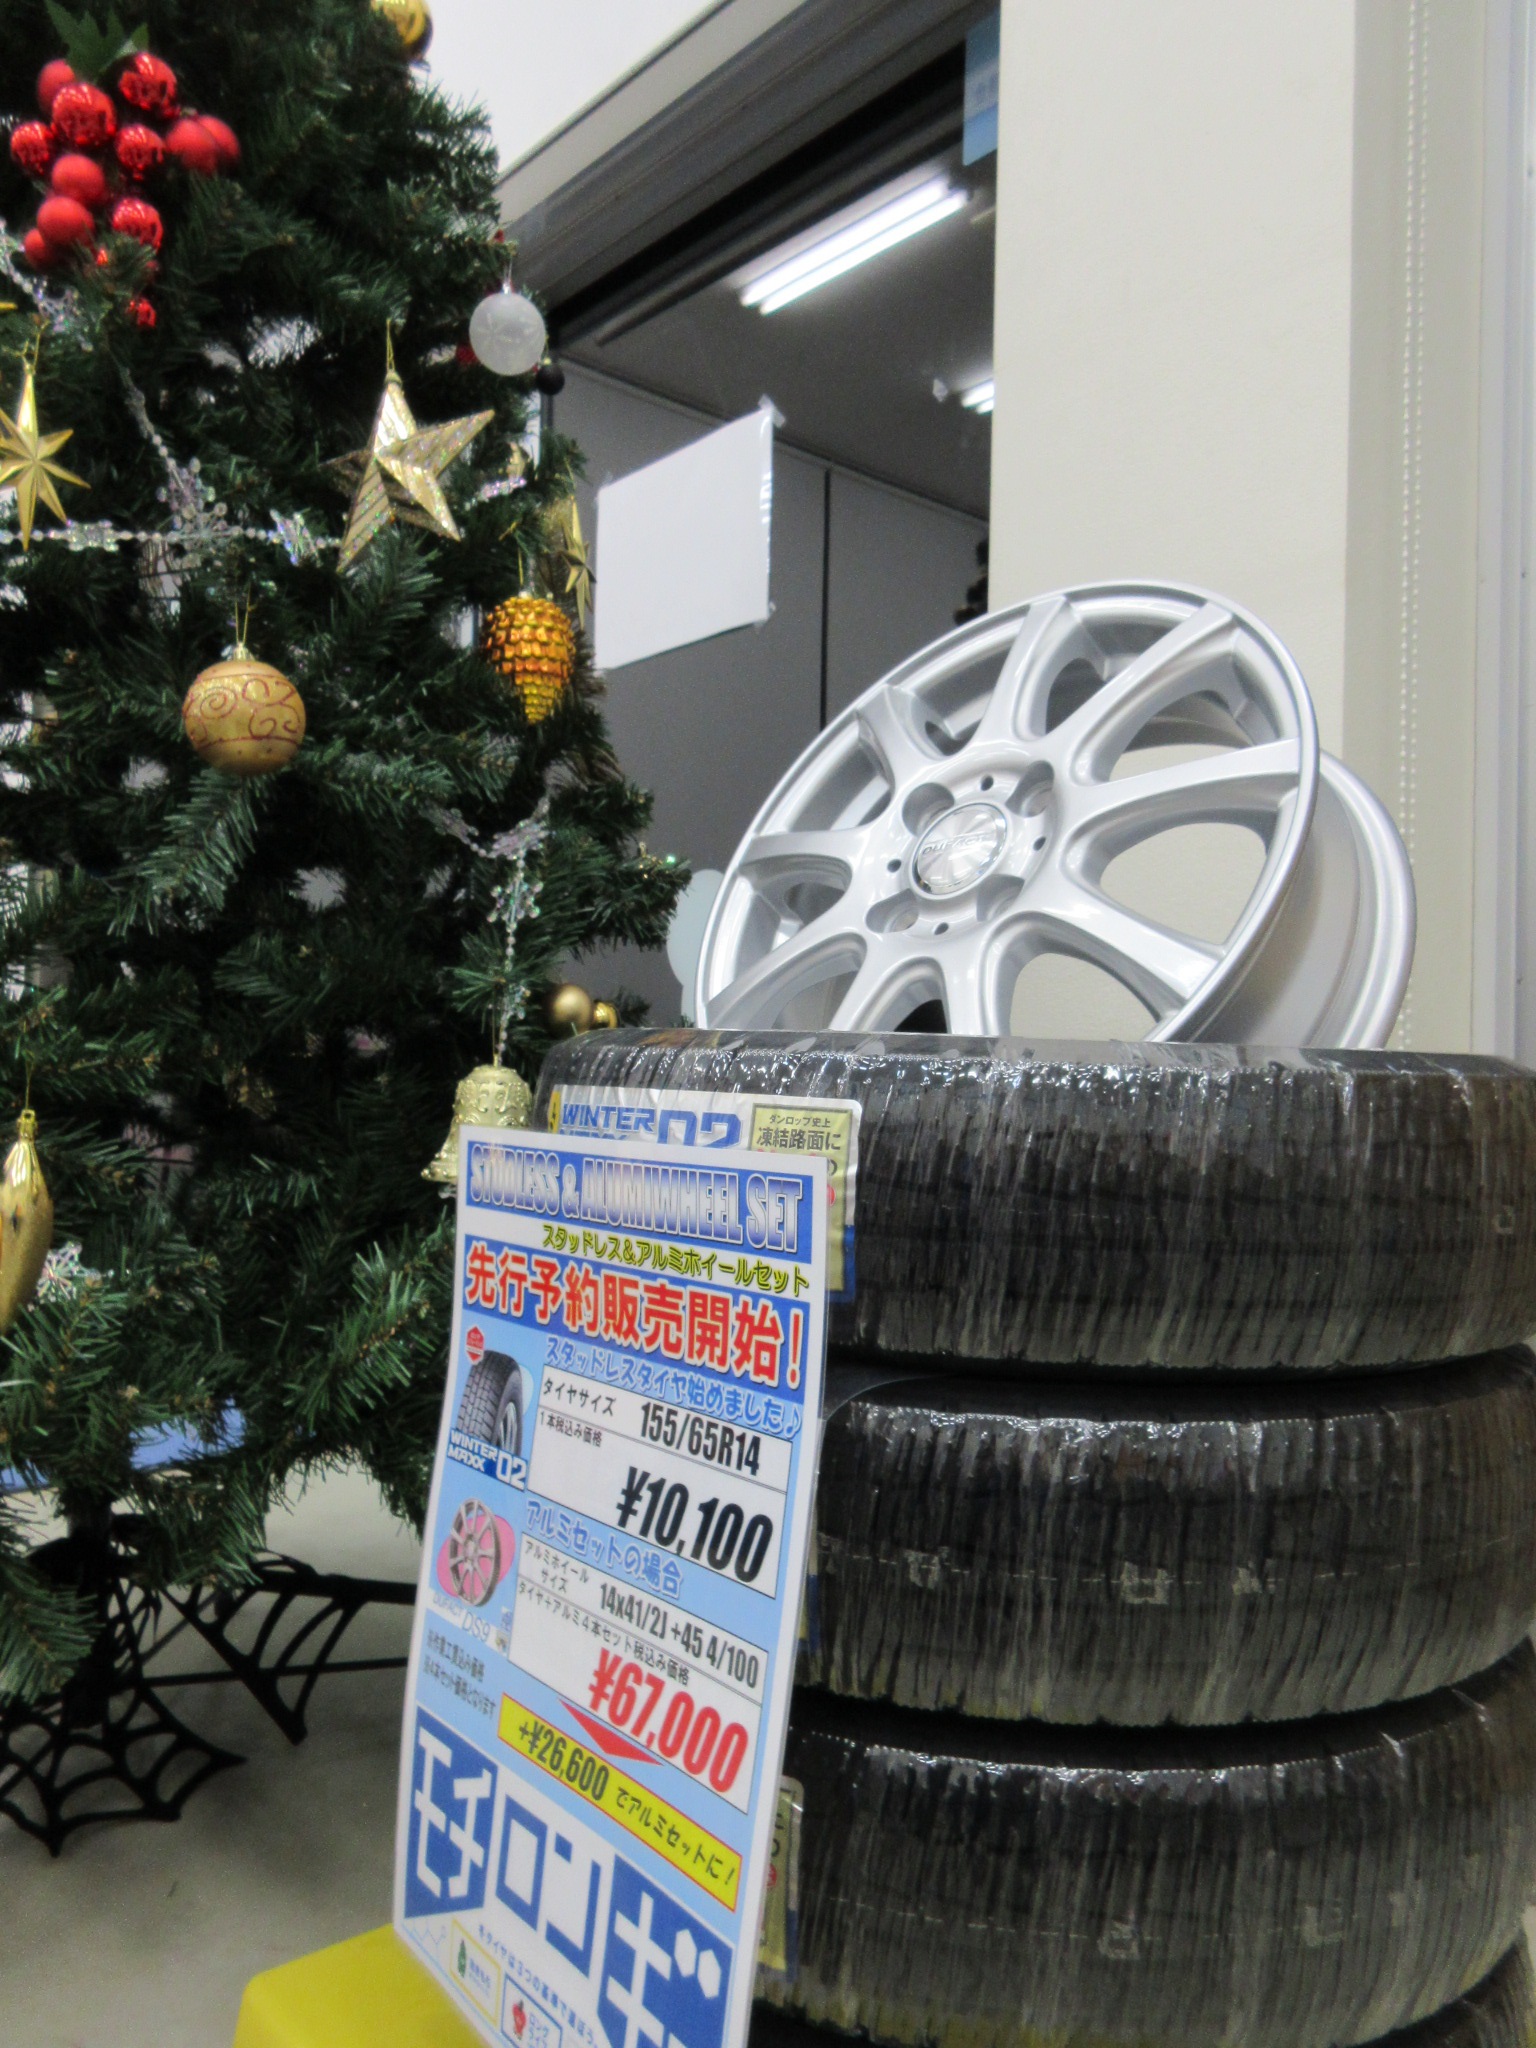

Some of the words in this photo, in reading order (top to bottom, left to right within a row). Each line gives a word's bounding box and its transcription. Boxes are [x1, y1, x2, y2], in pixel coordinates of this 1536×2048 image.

[563, 1102, 655, 1133] WINTER
[757, 1127, 841, 1151] 凍結路面に
[769, 1114, 831, 1128] ダンロップ史上
[470, 1145, 560, 1215] STUDLESS
[563, 1165, 579, 1218] &
[747, 1174, 803, 1253] SET
[543, 1225, 809, 1296] スタッドレス&アルミホイールセット
[447, 1443, 486, 1473] MAXX
[450, 1429, 498, 1462] WINTER
[496, 1448, 528, 1491] 02
[543, 1378, 616, 1417] タイヤサイズ
[640, 1401, 761, 1476] 155/65R14
[527, 1499, 683, 1598] アルミセットの場合
[616, 1465, 774, 1584] ¥10,100
[524, 1541, 590, 1584] アルミホイール
[462, 1610, 491, 1643] DS9
[541, 1570, 568, 1593] サイズ
[671, 1622, 703, 1659] +45
[706, 1636, 759, 1689] 4/100
[588, 1647, 749, 1793] ¥67,000
